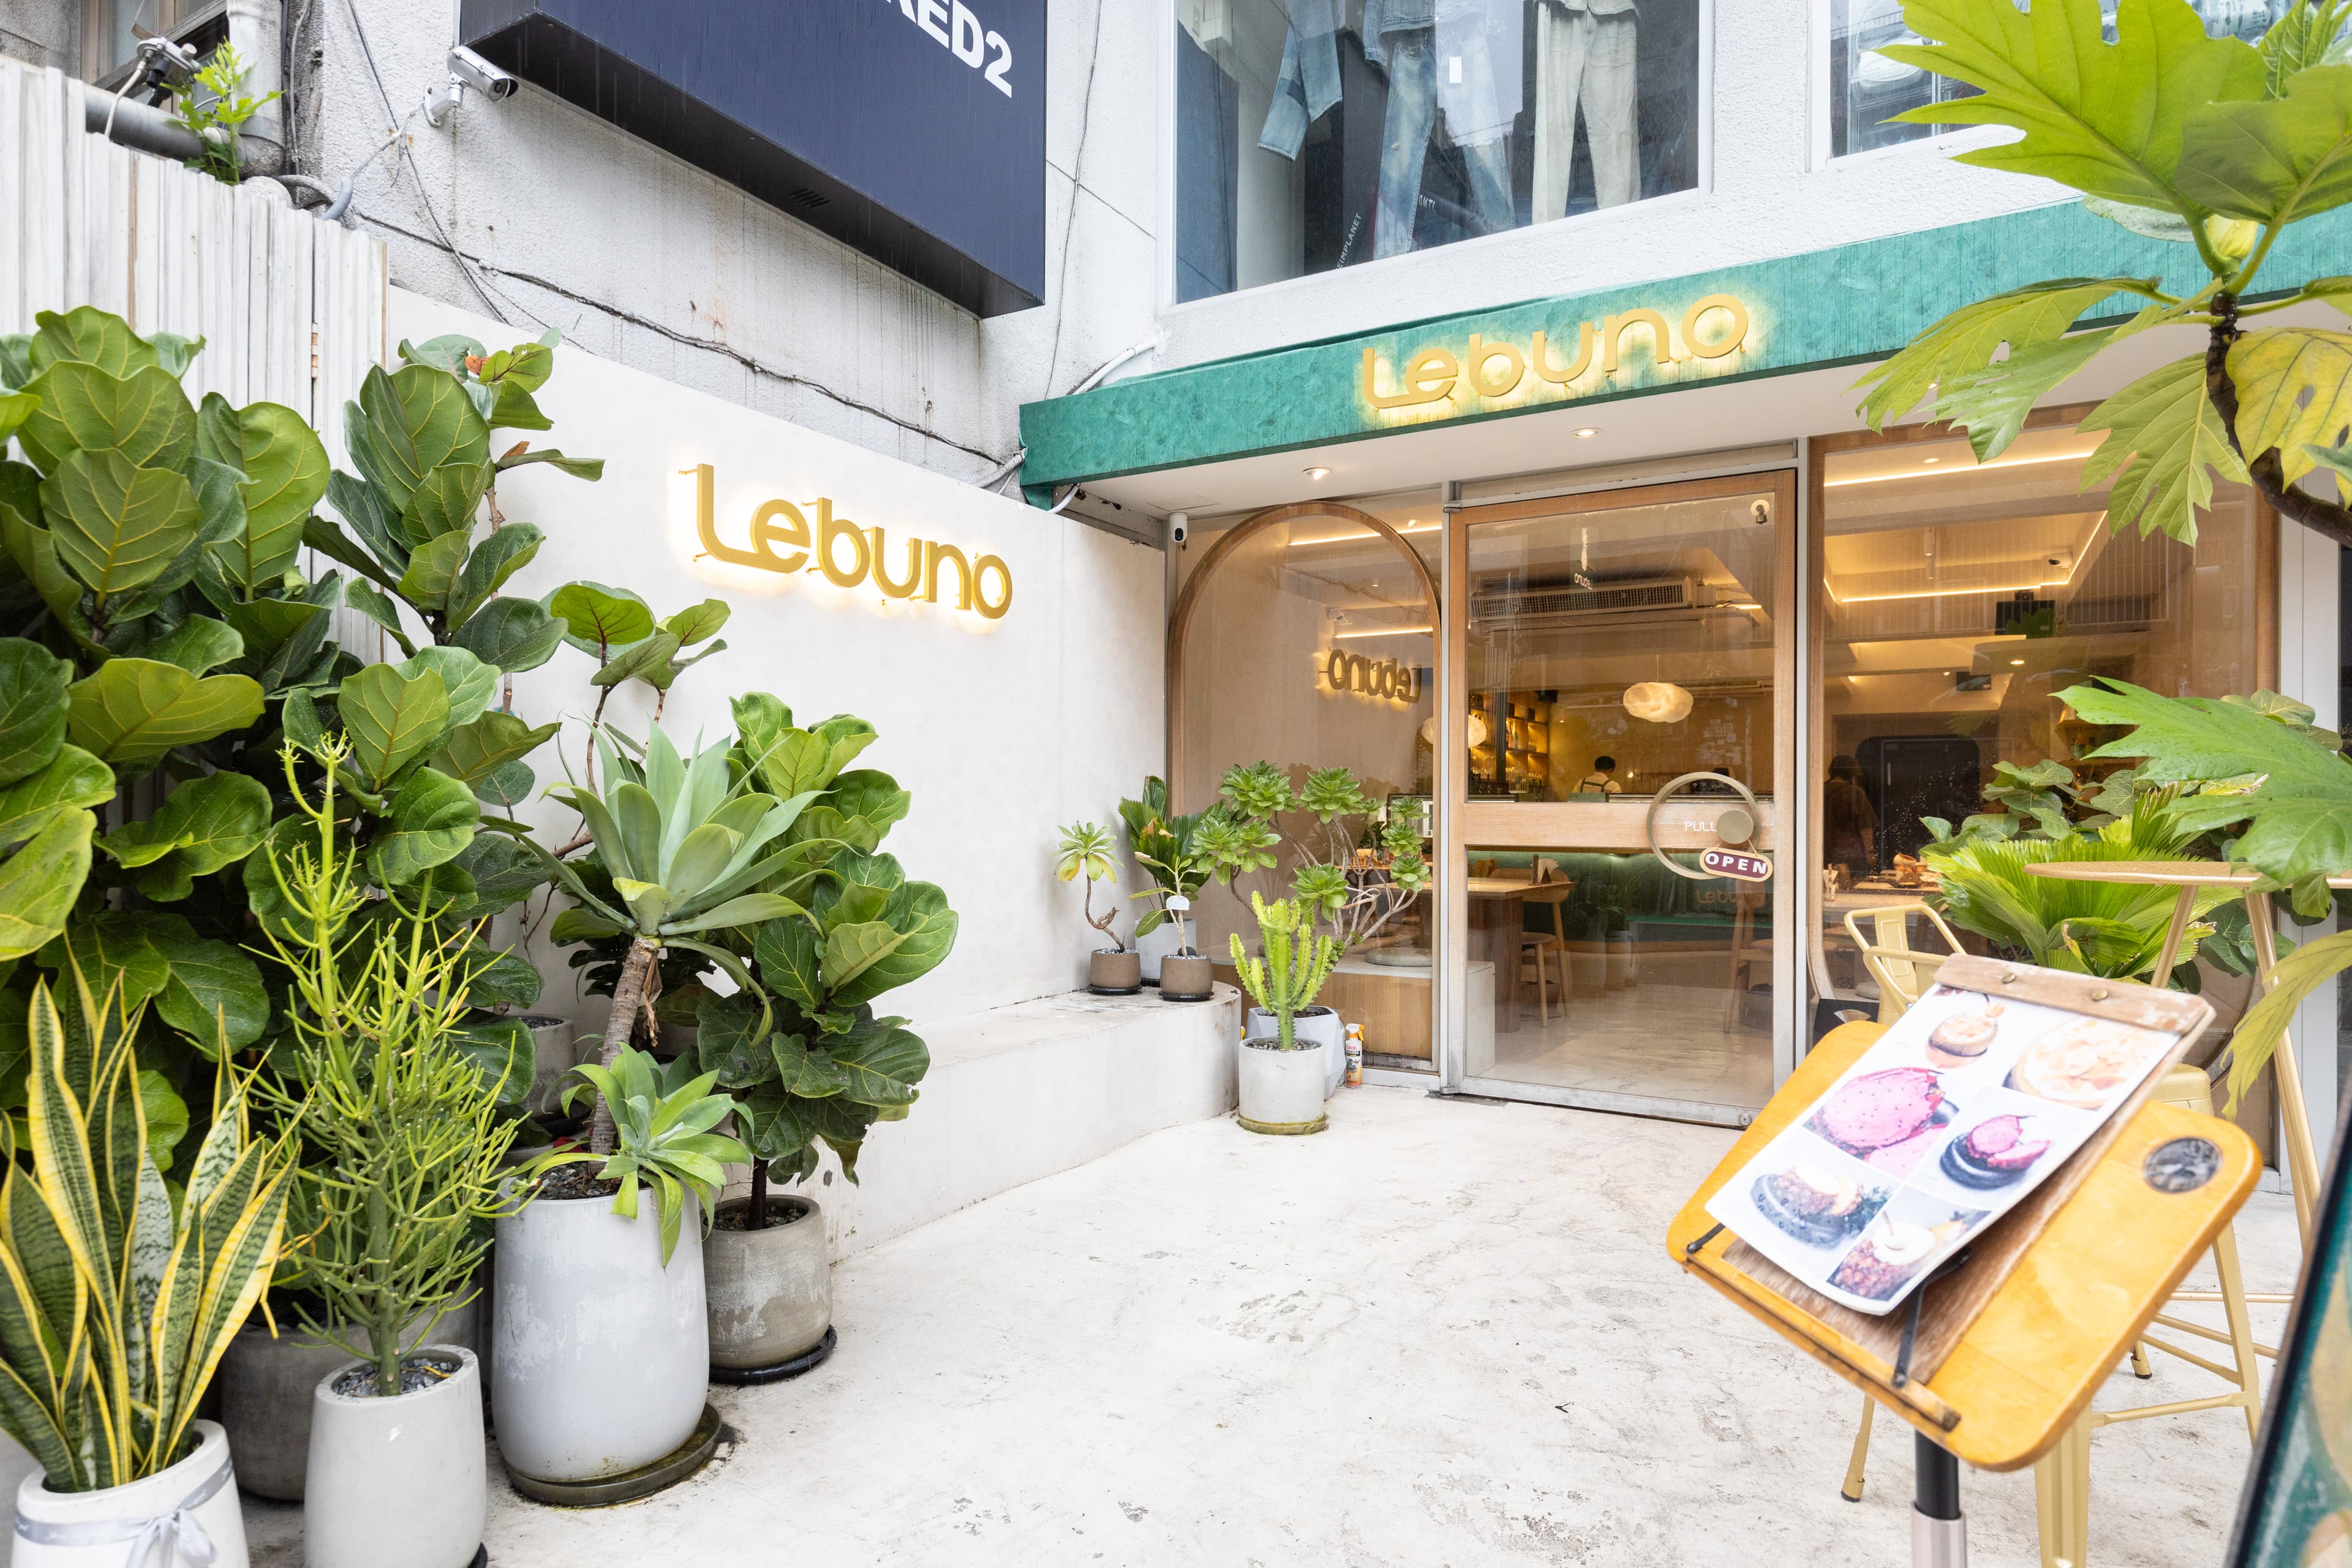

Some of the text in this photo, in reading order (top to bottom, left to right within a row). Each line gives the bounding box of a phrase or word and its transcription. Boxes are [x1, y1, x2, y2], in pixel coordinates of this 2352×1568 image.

[887, 0, 1012, 99] ED2
[1363, 293, 1749, 409] Lebuno
[696, 464, 1012, 619] Lebuno
[1684, 821, 1717, 832] PULL
[1705, 853, 1767, 875] OPEN
[1695, 889, 1737, 903] Lebu
